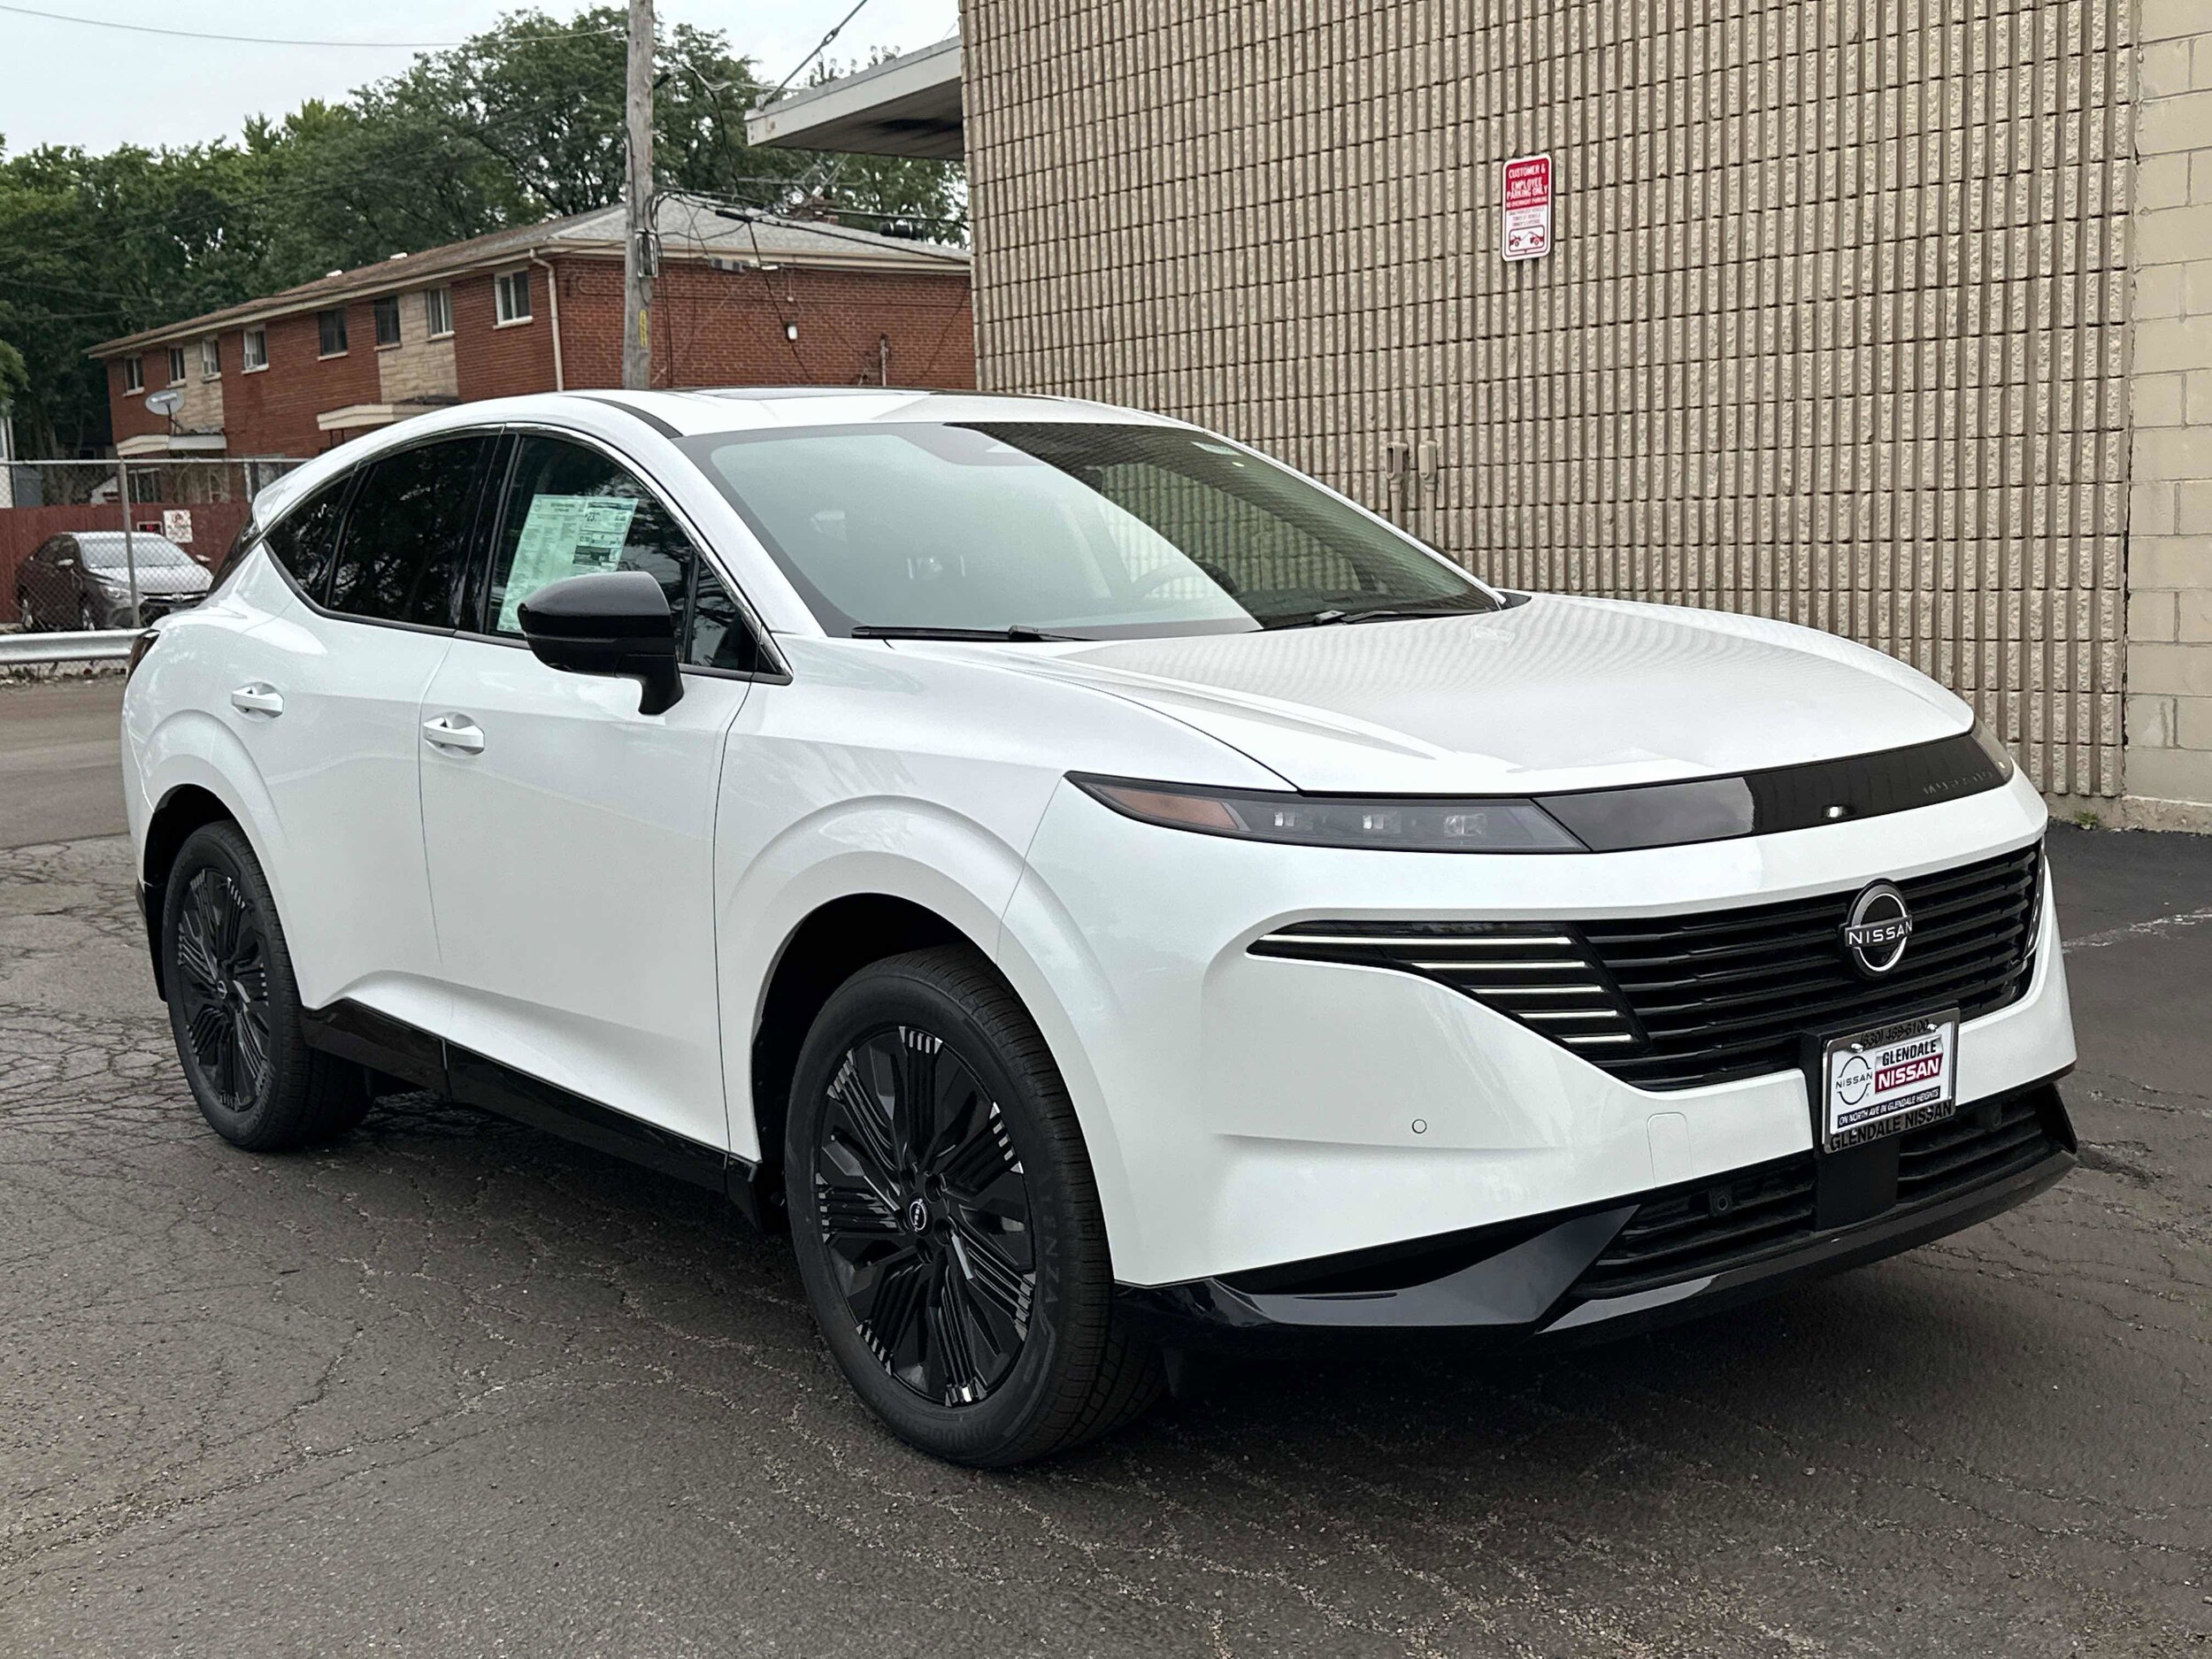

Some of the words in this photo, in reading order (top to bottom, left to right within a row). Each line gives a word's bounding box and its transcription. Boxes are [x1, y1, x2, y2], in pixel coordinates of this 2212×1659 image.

[1508, 165, 1540, 180] CUSTOMER
[1510, 176, 1543, 191] EMPLOYEE
[1848, 919, 1912, 945] NISSAN
[1882, 1039, 1937, 1067] GLENDALE
[1835, 1071, 1873, 1089] NISSAN
[1878, 1057, 1940, 1089] NISSAN
[1839, 1116, 1847, 1125] ON
[1848, 1110, 1868, 1124] NORTH
[1869, 1106, 1880, 1117] AVE
[1887, 1095, 1916, 1111] GLENDALE
[1916, 1088, 1939, 1102] HEIGHTS
[1831, 1116, 1901, 1151] GLENDALE
[1905, 1100, 1953, 1130] NISSAN
